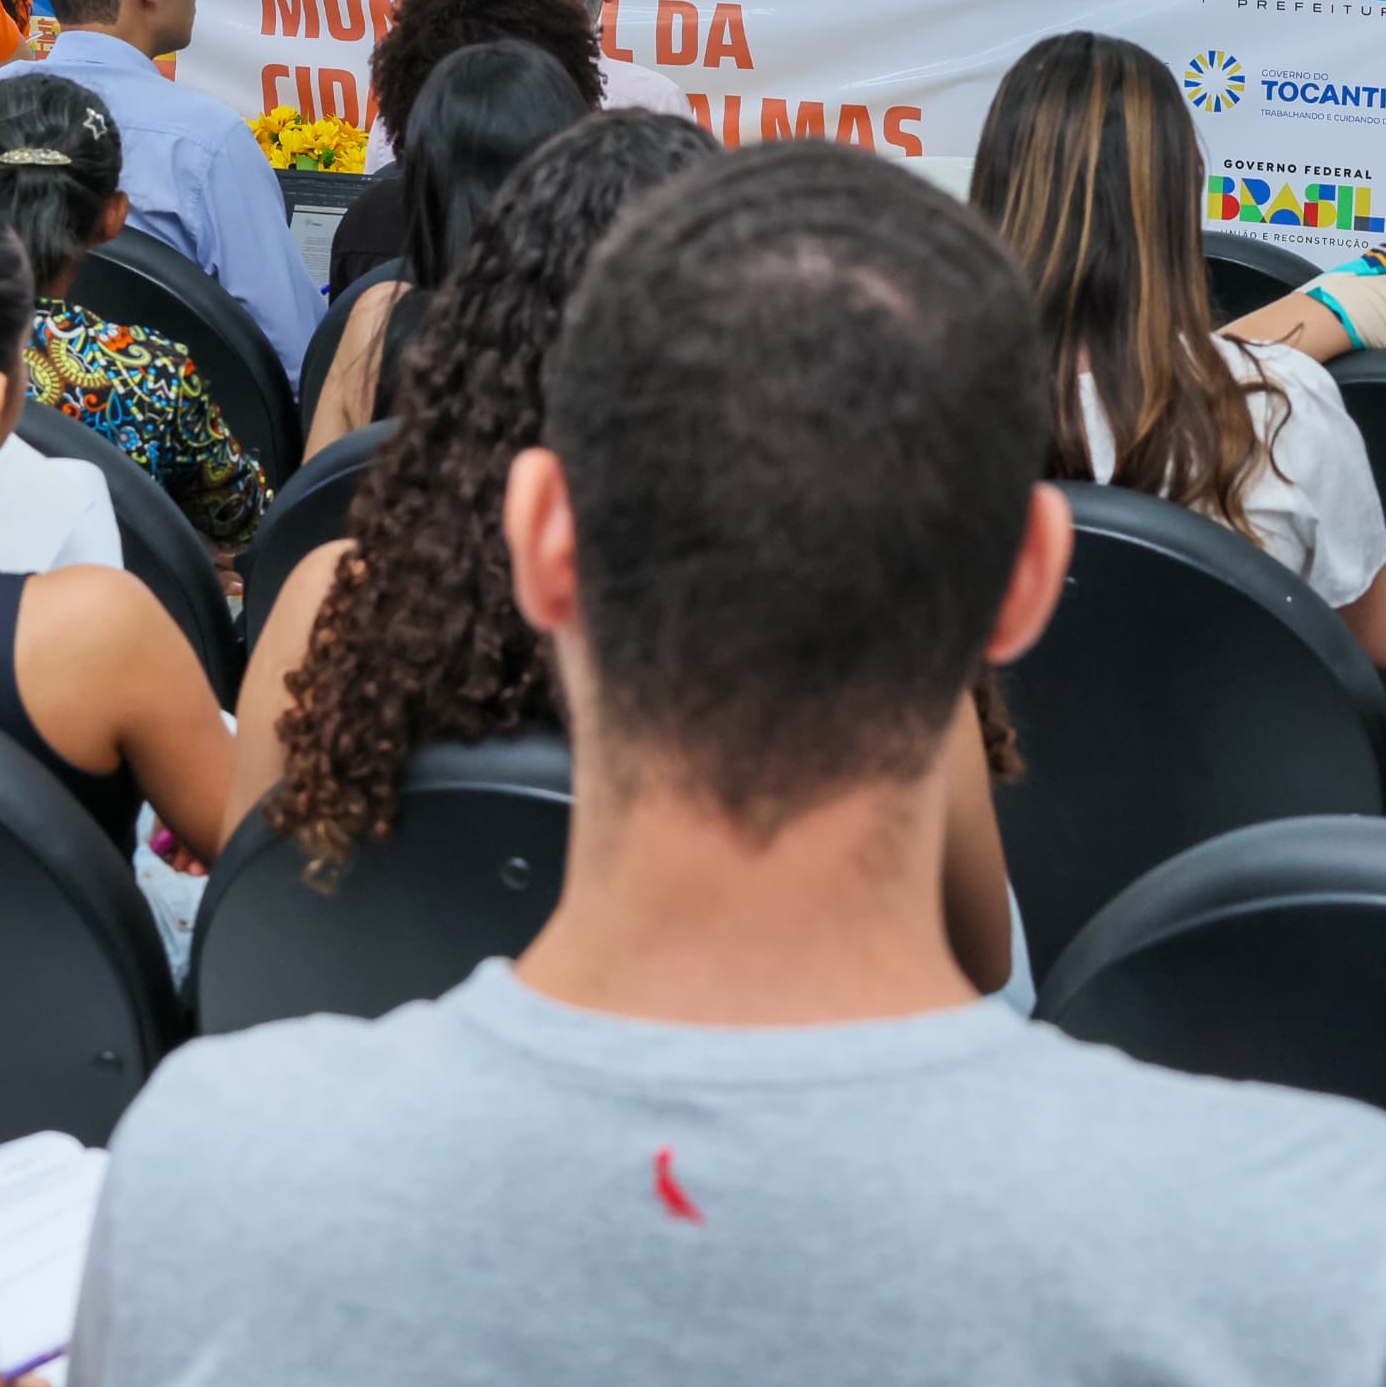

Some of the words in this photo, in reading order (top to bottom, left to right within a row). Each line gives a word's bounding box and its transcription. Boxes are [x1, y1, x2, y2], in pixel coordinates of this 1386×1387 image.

[656, 0, 753, 70] DA
[1261, 69, 1310, 81] GOVERNO
[1313, 72, 1329, 81] DO
[1261, 108, 1324, 121] TRABALHANDO
[1326, 113, 1332, 122] E
[1334, 114, 1381, 125] CUIDANDO
[1224, 159, 1296, 174] GOVERNO
[1305, 166, 1372, 180] FEDERAL
[1207, 175, 1385, 233] BRASIL
[1263, 233, 1269, 241] E
[1274, 234, 1369, 249] RECONSTRUÇÃO
